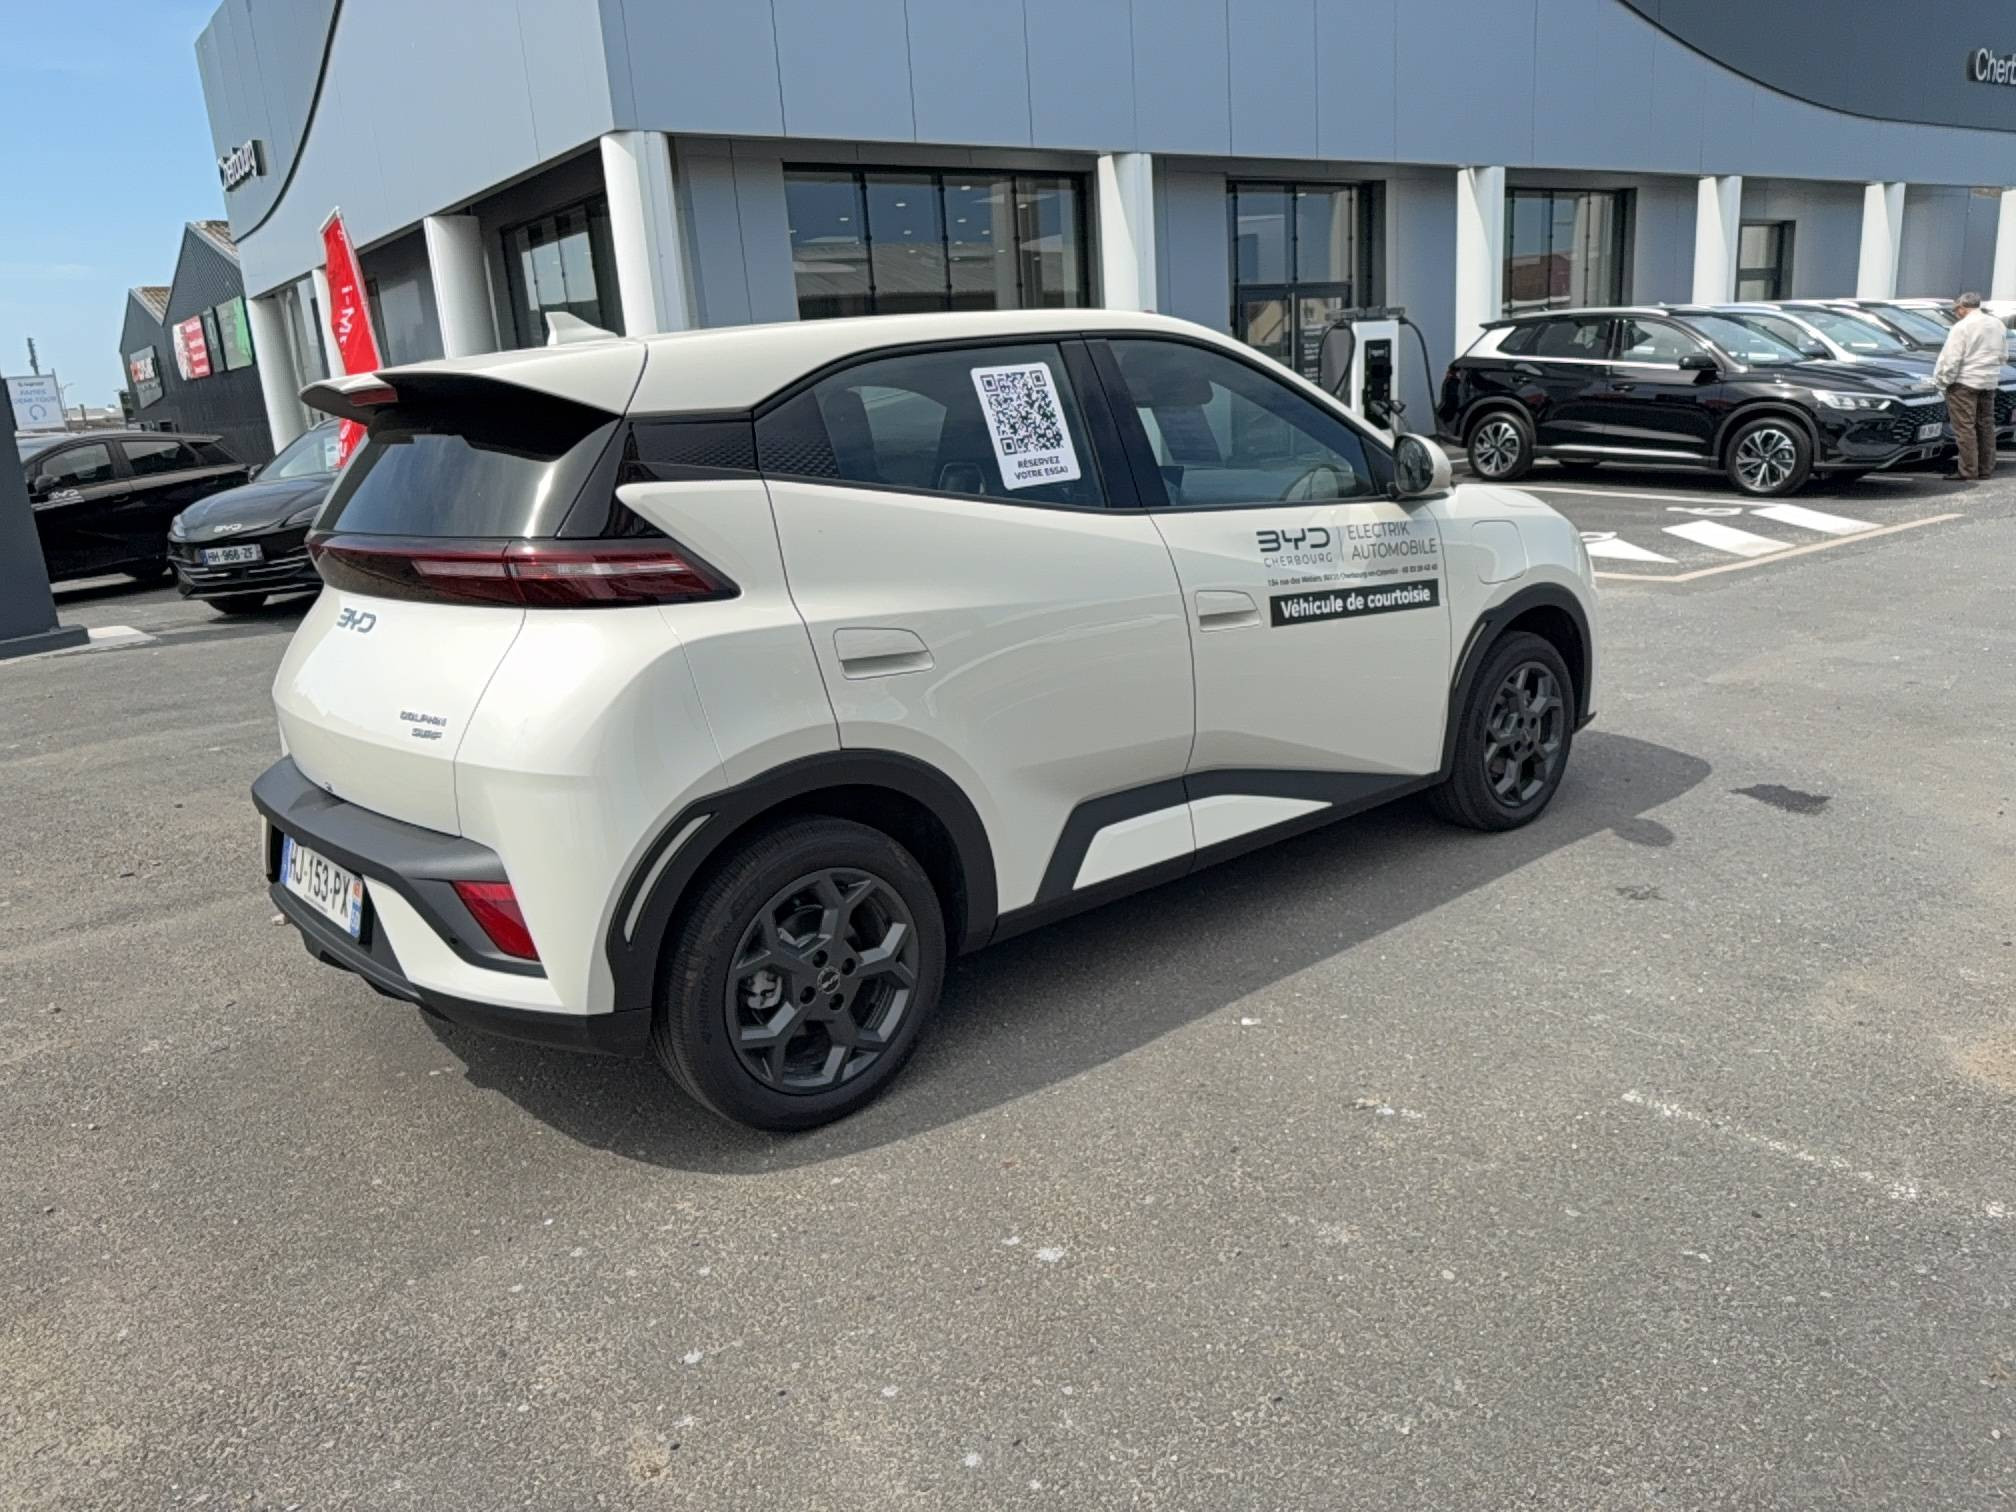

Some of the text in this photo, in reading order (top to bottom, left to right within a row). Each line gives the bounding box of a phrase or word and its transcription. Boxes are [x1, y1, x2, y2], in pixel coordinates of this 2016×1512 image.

[217, 139, 257, 190] Cherbourg
[1014, 464, 1069, 480] VOTRE ESSAI
[1017, 455, 1060, 469] RÉSERVEZ
[1256, 527, 1331, 553] BYD
[1347, 520, 1411, 540] ELECTRIK
[1264, 552, 1333, 568] CHERBOURG
[1351, 538, 1437, 561] AUTOMOBILE
[1280, 585, 1431, 619] Véhicule de courtoisie
[336, 607, 377, 633] BYD
[399, 710, 447, 727] DOLPHIN
[411, 727, 442, 740] SURF
[289, 841, 351, 919] HJ-153-PX
